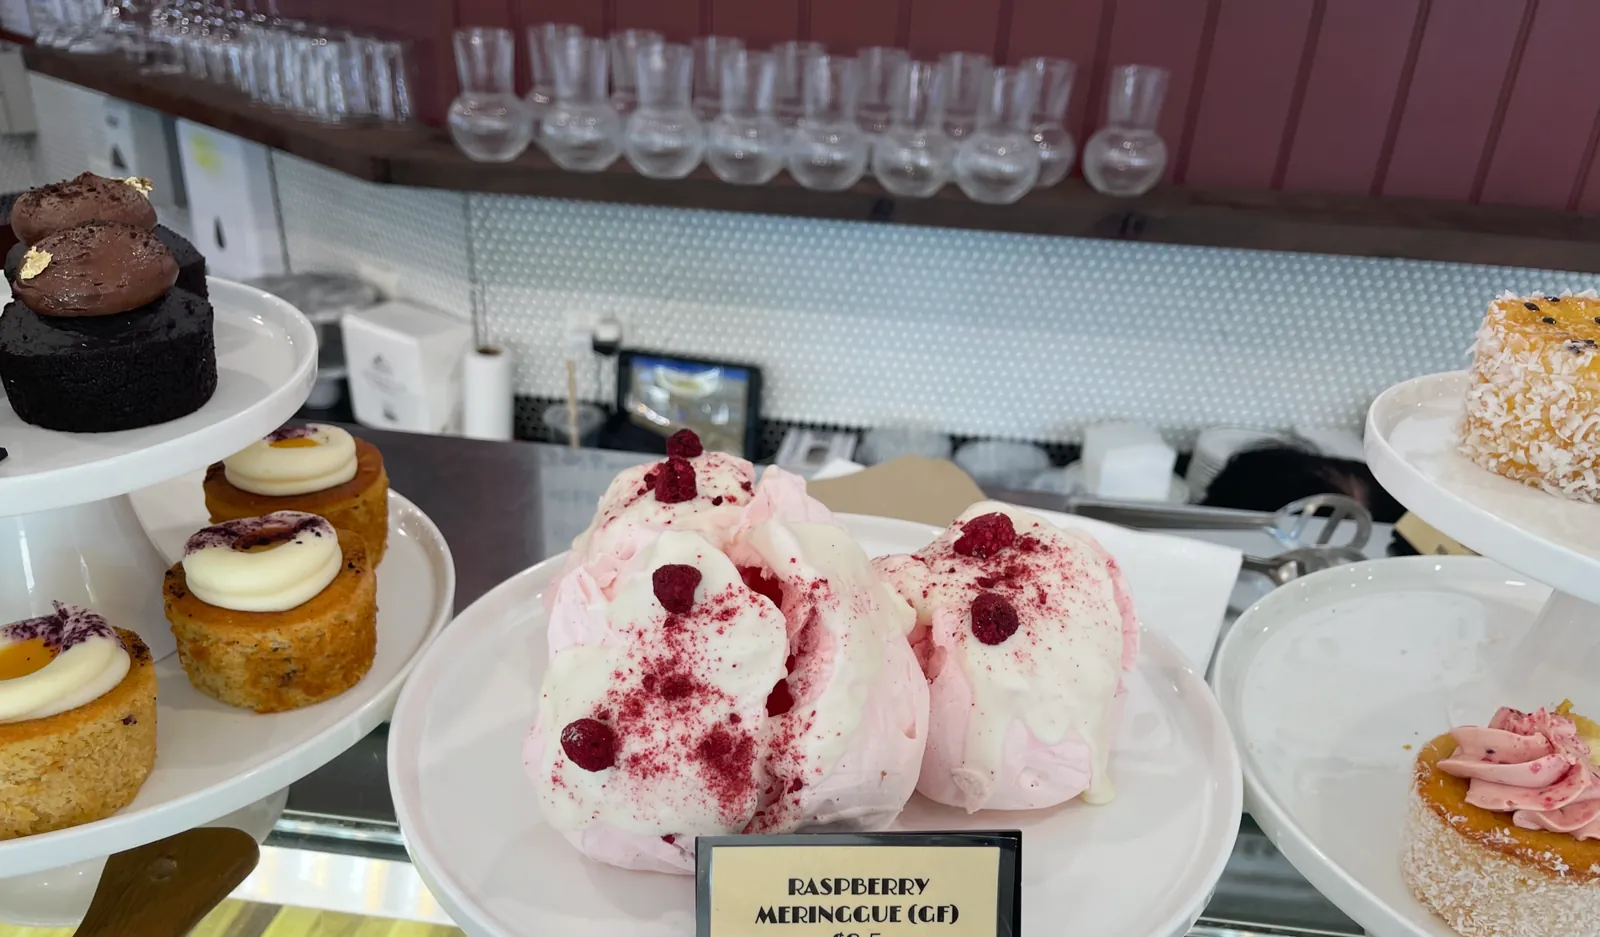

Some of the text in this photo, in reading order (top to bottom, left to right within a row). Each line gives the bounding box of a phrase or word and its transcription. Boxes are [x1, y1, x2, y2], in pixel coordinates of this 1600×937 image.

[788, 877, 930, 896] RASPBERRY
[754, 903, 960, 925] MERINGGUE (GF)
